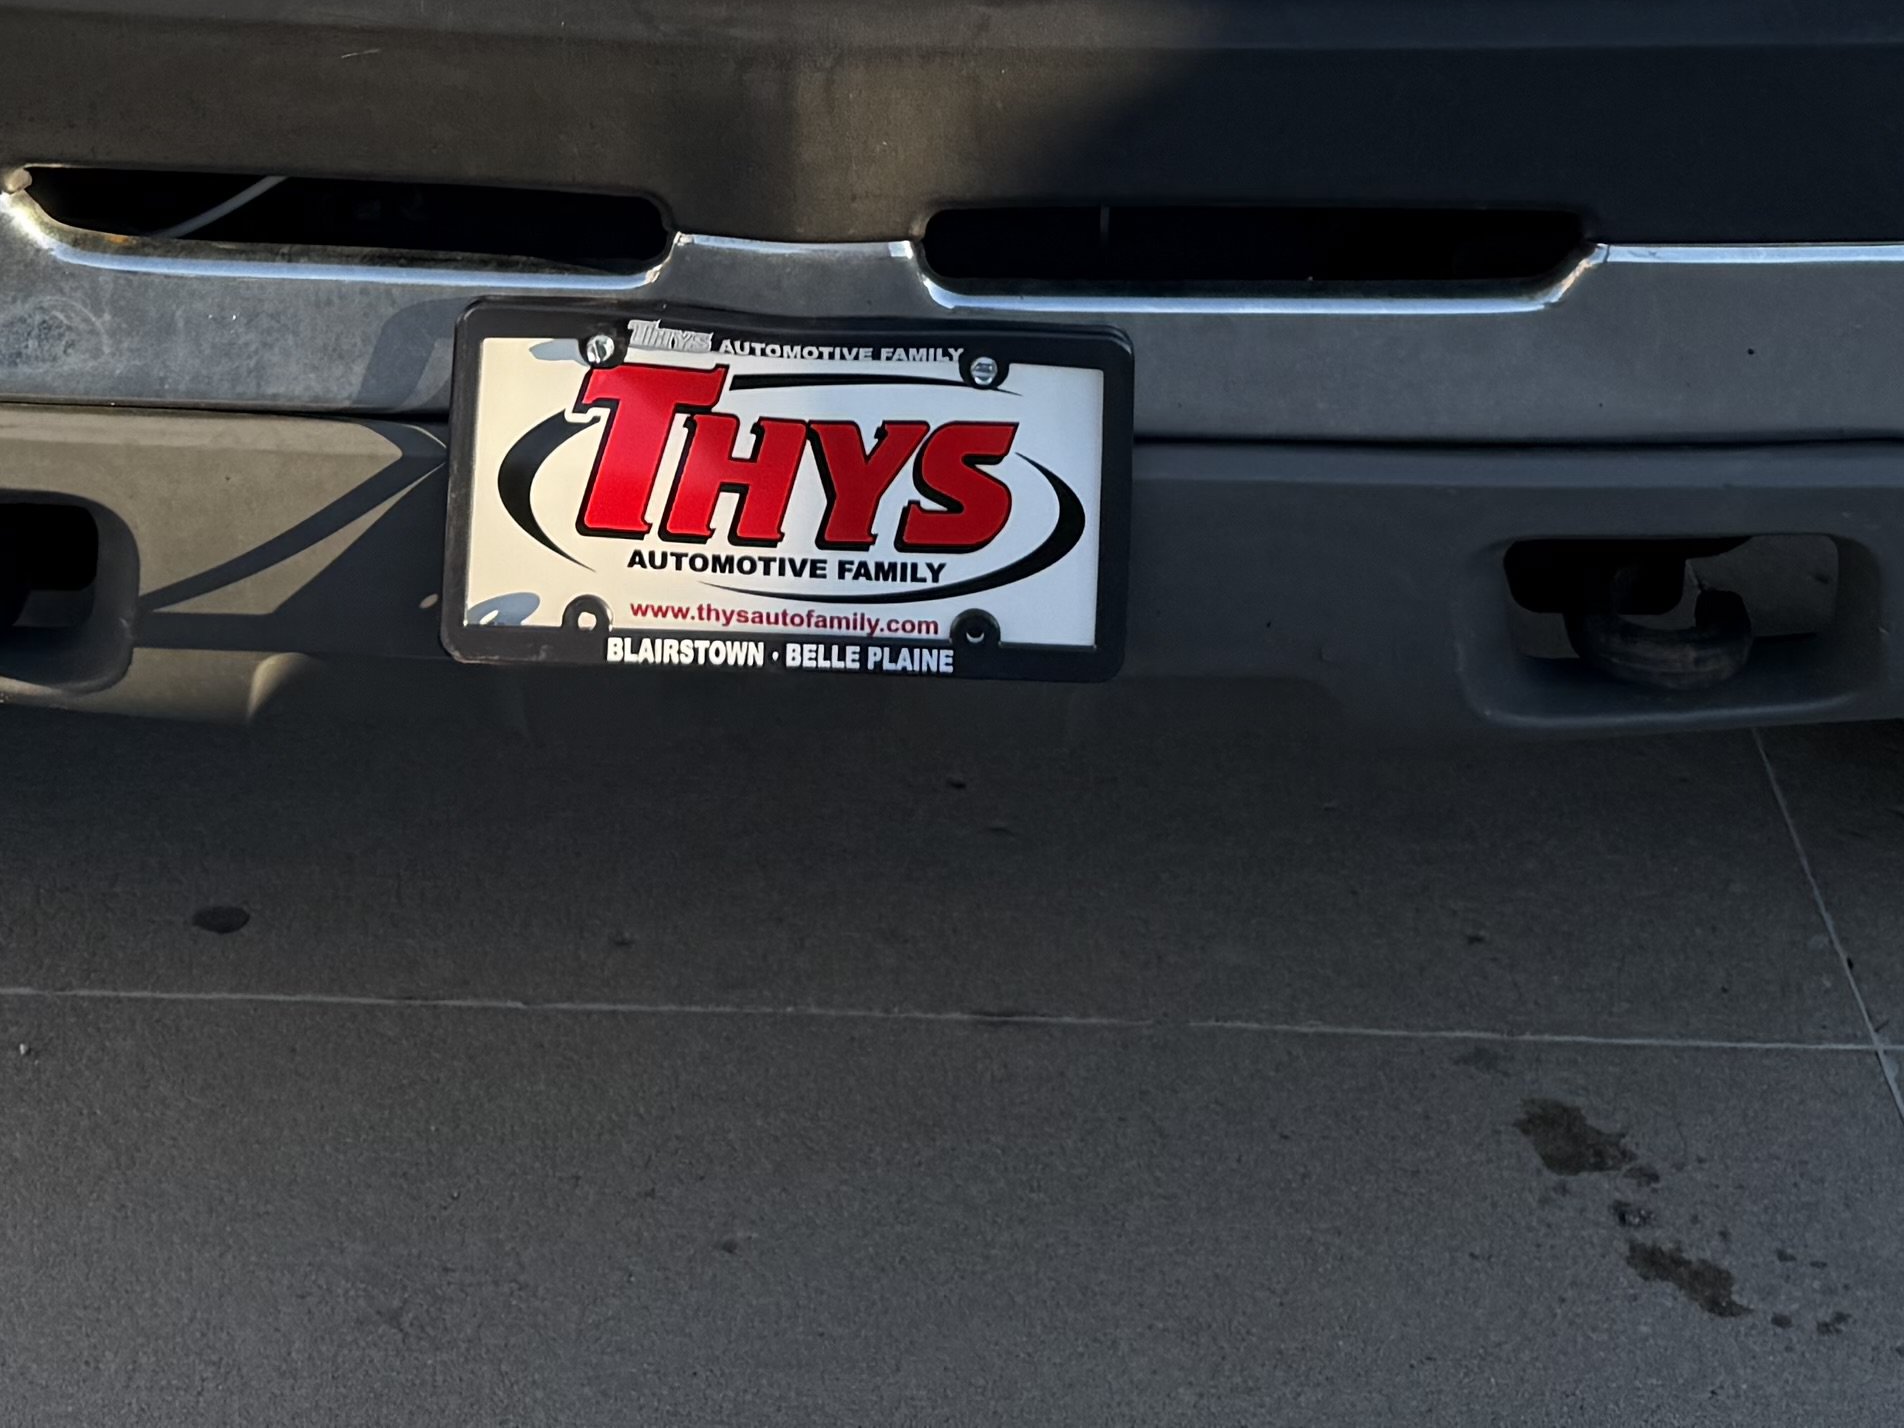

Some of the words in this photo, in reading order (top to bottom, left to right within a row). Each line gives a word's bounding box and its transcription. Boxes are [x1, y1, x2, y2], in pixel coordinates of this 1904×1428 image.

[719, 339, 873, 362] AUTOMOTIVE
[879, 347, 965, 363] FAMILY
[573, 362, 1020, 553] THYS
[626, 549, 828, 580] AUTOMOTIVE
[837, 558, 947, 584] FAMILY
[629, 601, 940, 638] www.thysautofamily.com
[606, 637, 765, 668] BLAIRSTOWN
[785, 643, 860, 670] BELLE
[866, 646, 954, 673] PLAINE
